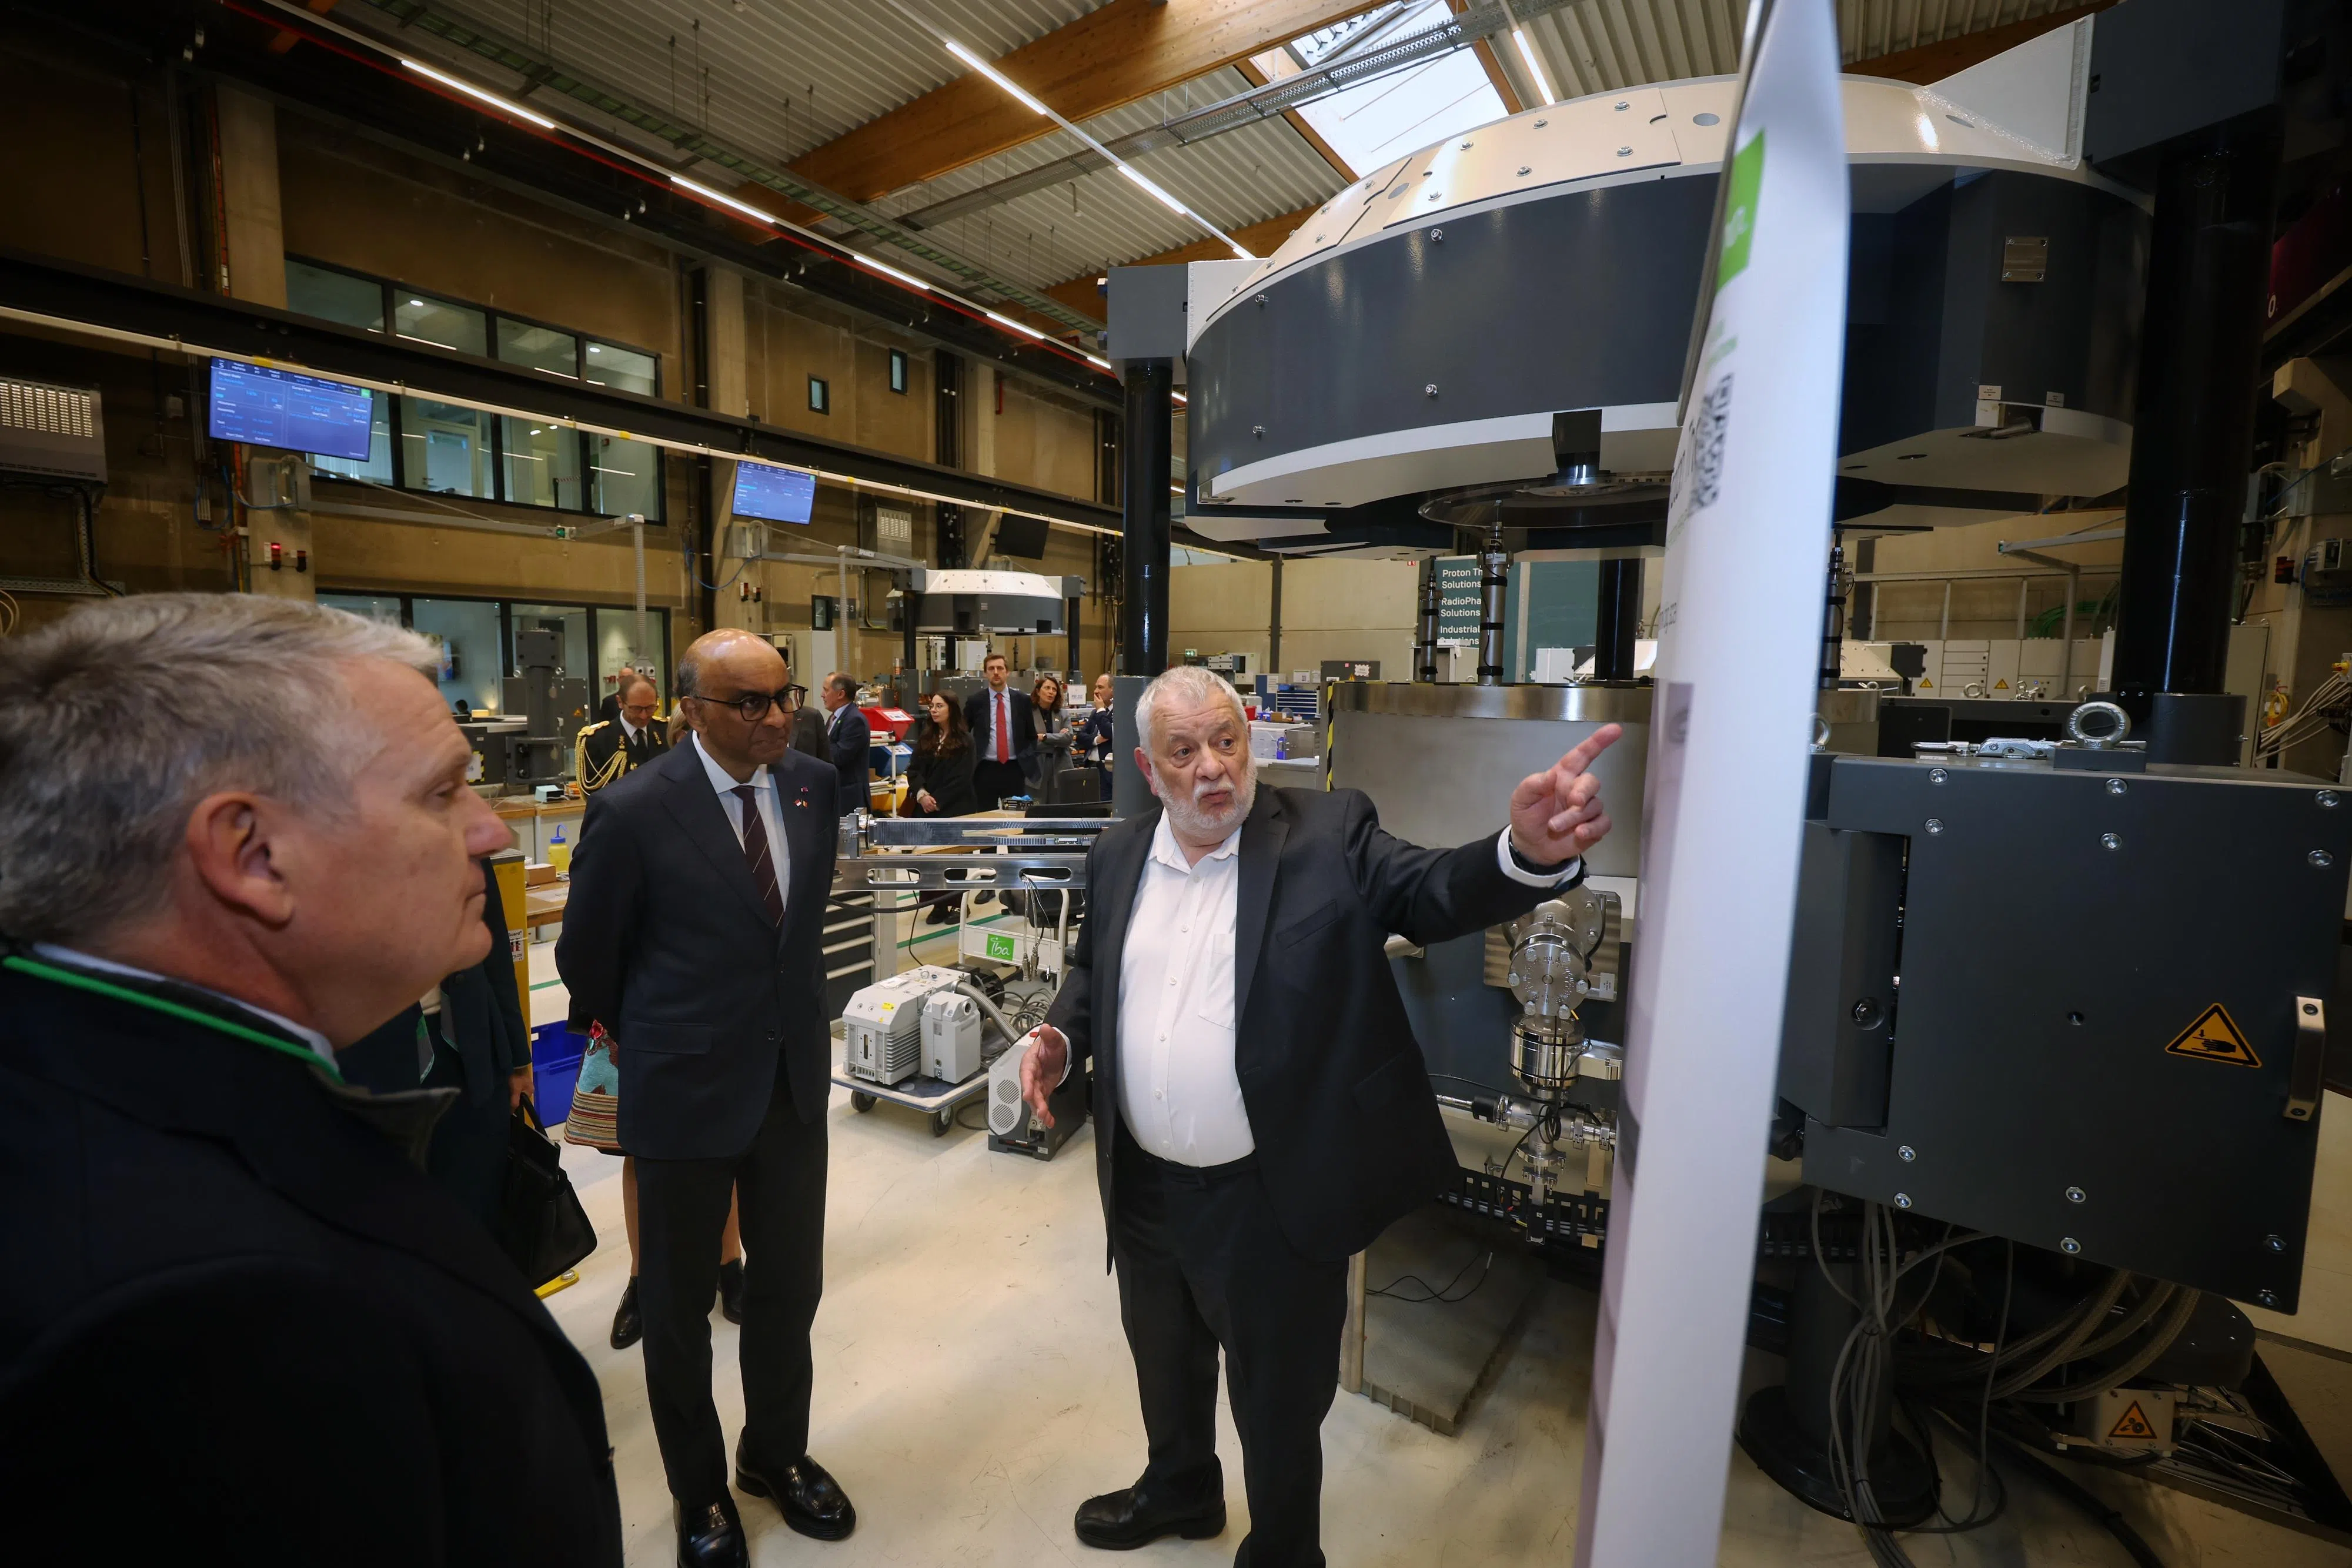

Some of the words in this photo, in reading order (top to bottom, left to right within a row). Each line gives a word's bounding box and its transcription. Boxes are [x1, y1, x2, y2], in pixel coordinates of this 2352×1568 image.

[1442, 569, 1471, 577] Proton
[1472, 568, 1483, 576] Th
[1442, 580, 1481, 589] Solutions
[1441, 597, 1481, 606] RadioPha
[1441, 609, 1481, 617] Solutions
[1440, 625, 1480, 633] Industrial
